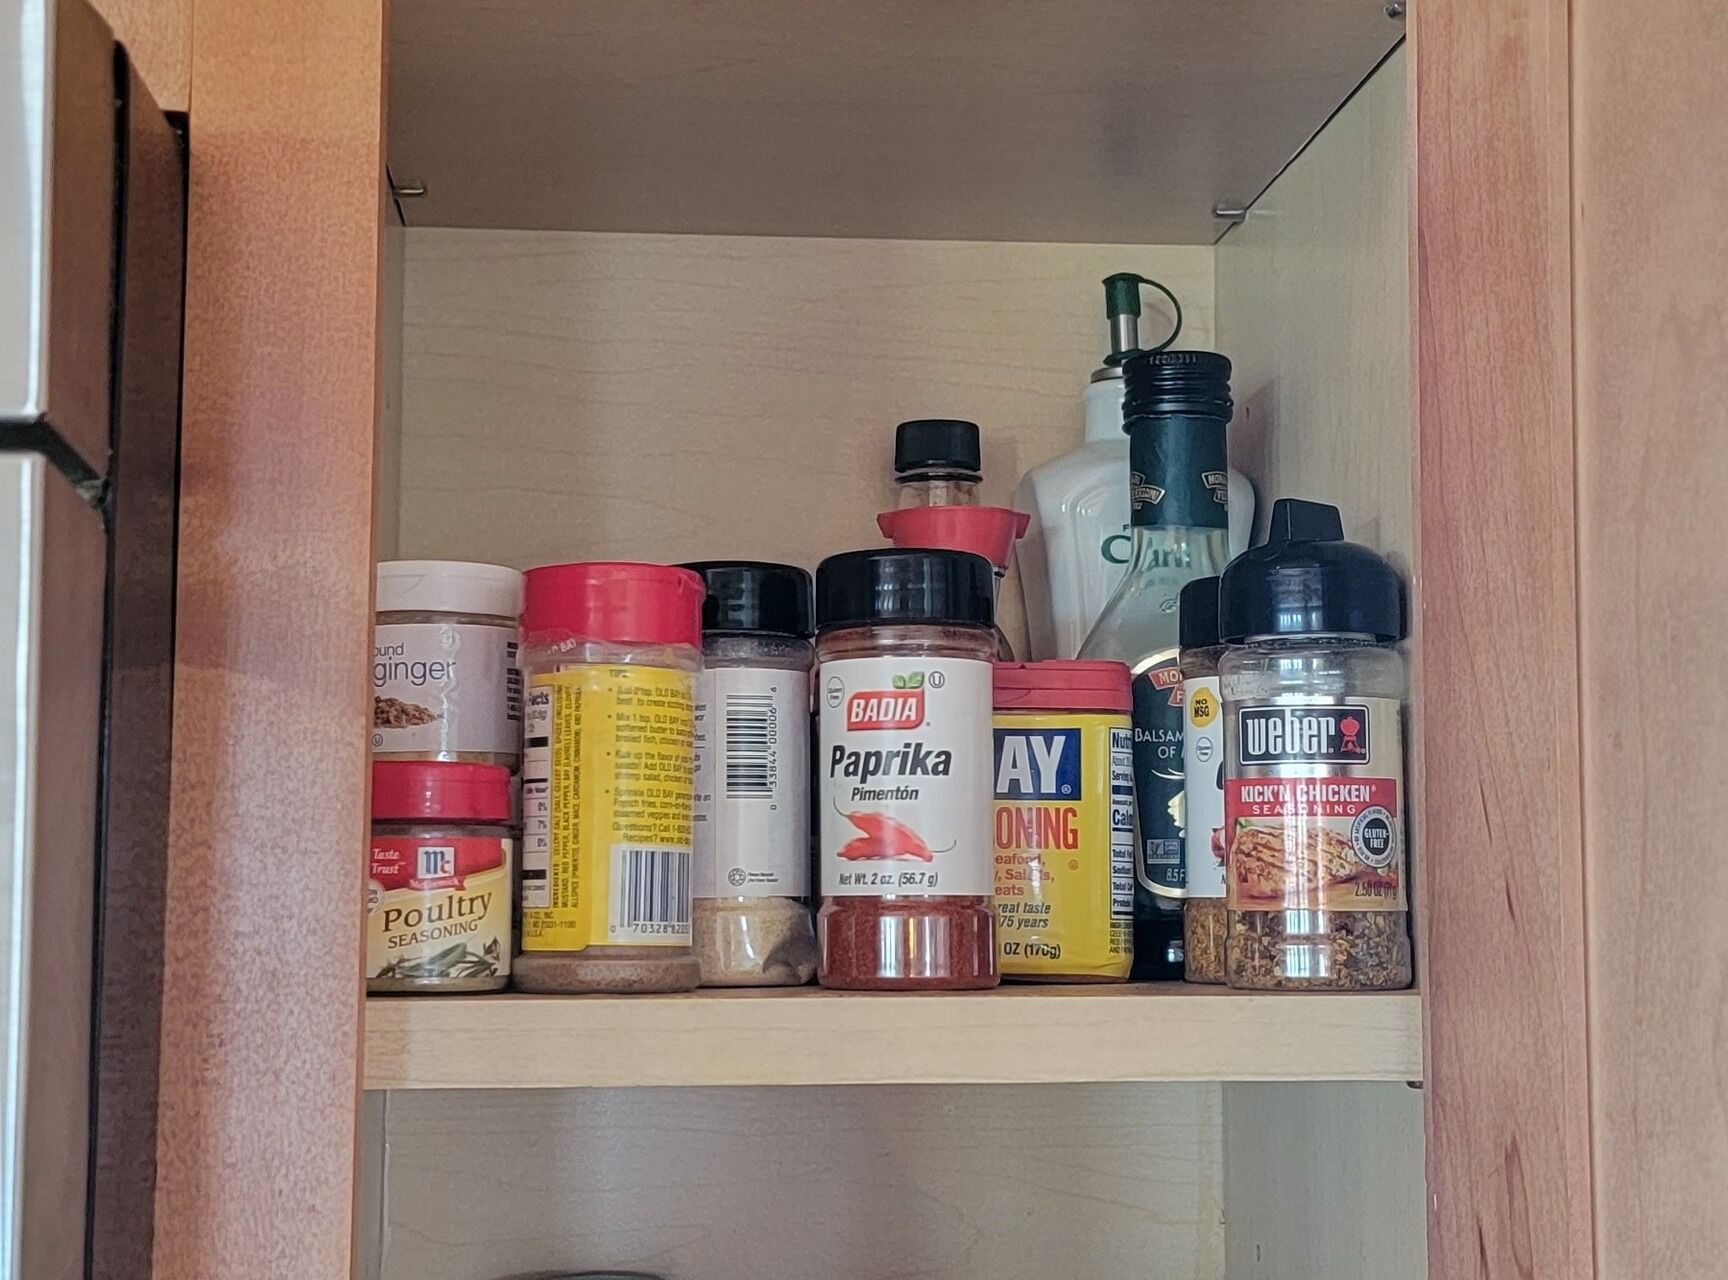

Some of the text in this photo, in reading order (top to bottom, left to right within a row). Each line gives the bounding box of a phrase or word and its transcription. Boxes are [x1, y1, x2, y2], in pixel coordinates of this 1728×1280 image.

[373, 657, 457, 687] ginger
[1195, 698, 1207, 706] NO
[850, 698, 917, 722] BADIA
[1194, 706, 1210, 718] MSG
[1246, 708, 1335, 756] weber
[769, 707, 777, 787] 33844 00006
[1158, 746, 1176, 759] OF
[645, 751, 655, 760] the
[644, 762, 657, 770] Add
[659, 762, 671, 771] OLD
[830, 742, 952, 784] Paprika
[646, 788, 661, 798] OLD
[662, 789, 674, 798] BAY
[851, 785, 919, 802] Pimentón
[1241, 784, 1370, 803] KICK'N CHICKEN
[1253, 805, 1356, 815] SEASONING
[658, 823, 671, 832] Call
[1364, 828, 1389, 839] GLUTEN-
[623, 833, 658, 843] Recipes?
[1370, 838, 1384, 848] FREE
[839, 872, 938, 888] Net Wt. 2 oz. (56.7 g)
[382, 892, 493, 933] Poultry
[1016, 917, 1049, 930] years
[388, 919, 479, 949] SEASONING
[1004, 942, 1020, 955] OZ
